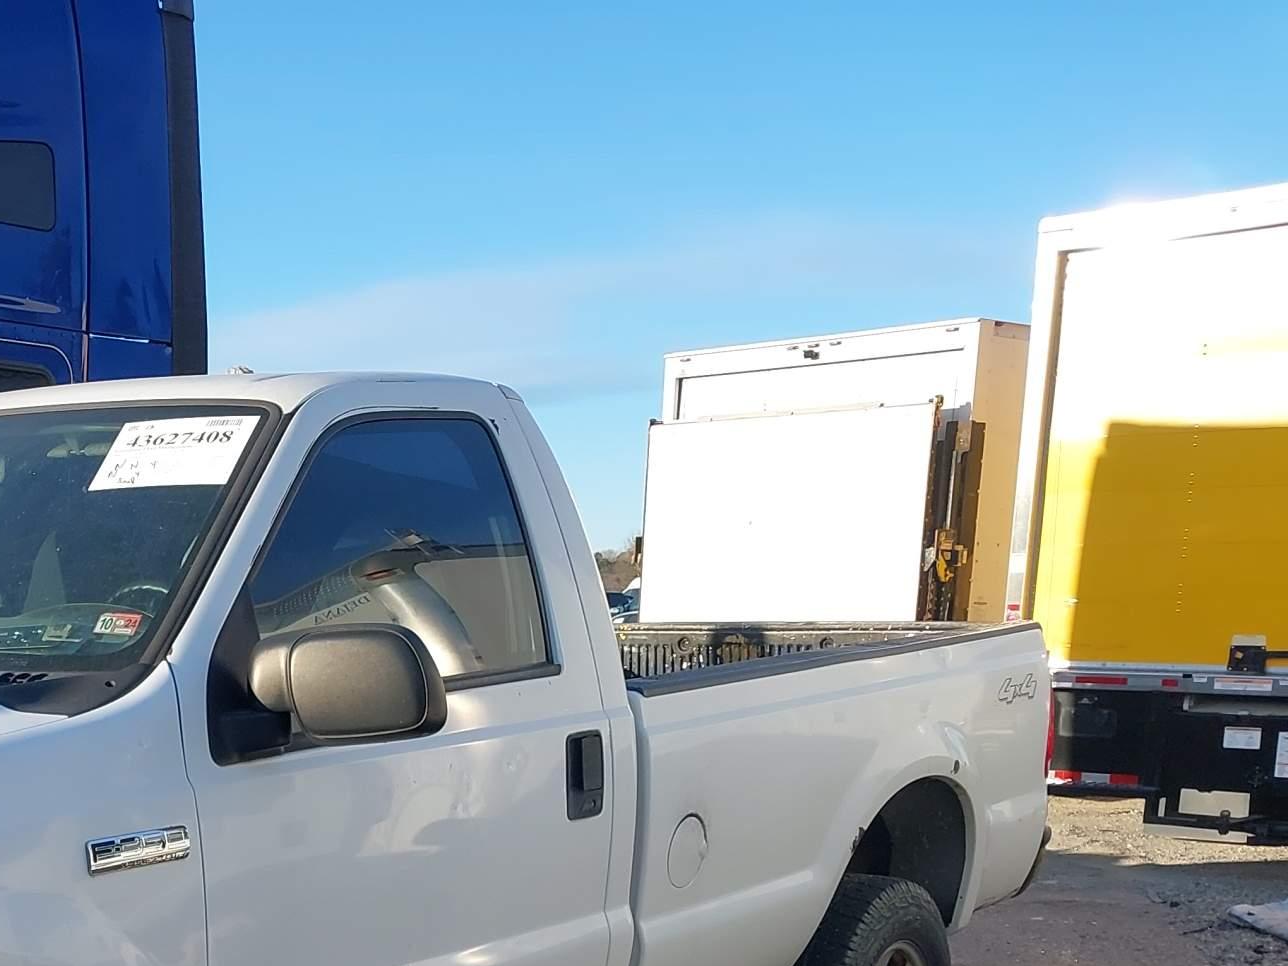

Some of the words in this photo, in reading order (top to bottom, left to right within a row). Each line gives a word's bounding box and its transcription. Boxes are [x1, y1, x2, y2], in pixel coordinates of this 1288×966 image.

[126, 430, 234, 448] 43627408
[100, 617, 114, 631] 10
[125, 619, 137, 629] 24
[998, 672, 1037, 705] 4x4
